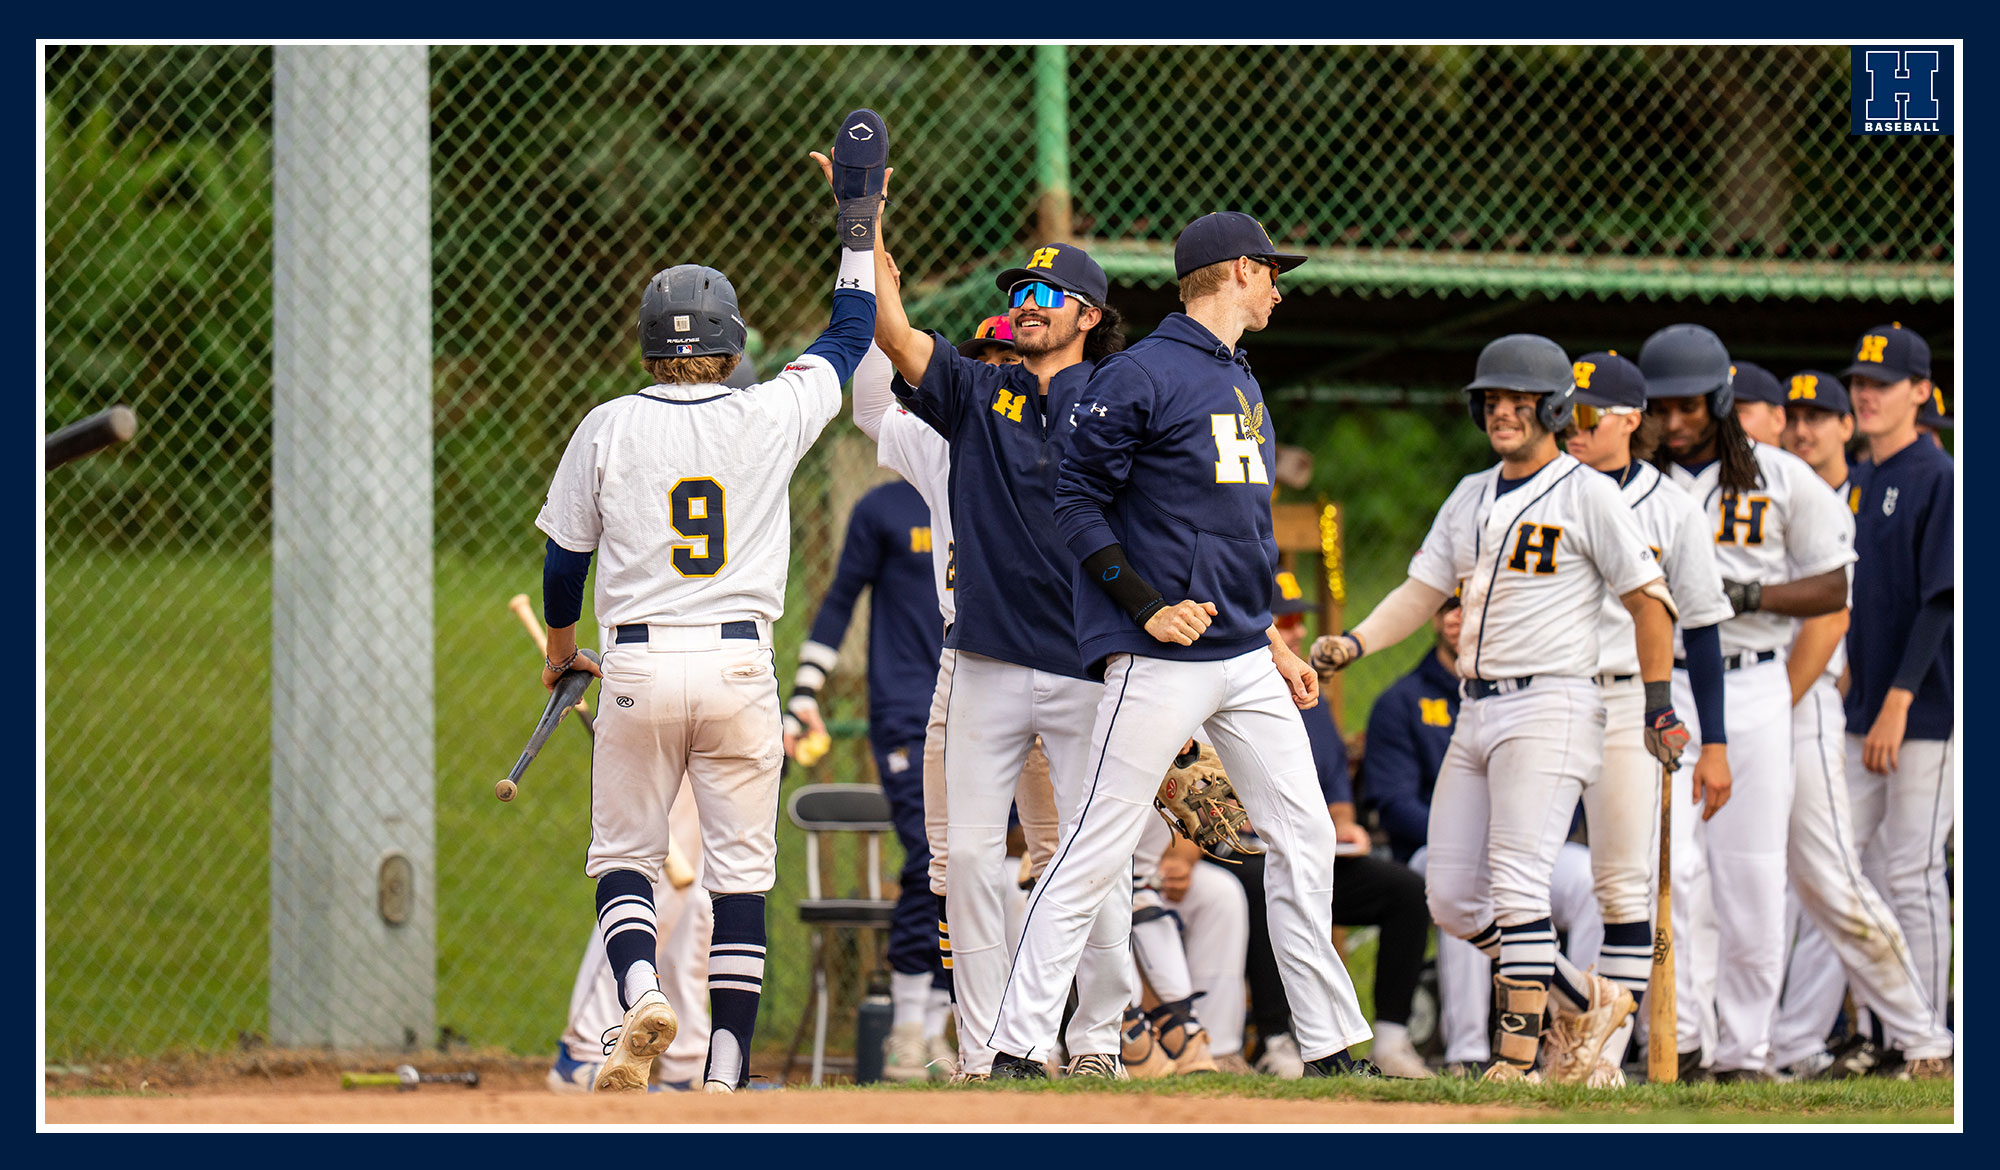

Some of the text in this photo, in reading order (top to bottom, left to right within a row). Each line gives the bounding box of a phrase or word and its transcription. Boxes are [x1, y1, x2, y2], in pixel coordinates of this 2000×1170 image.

[1026, 247, 1060, 269] H
[1857, 335, 1889, 364] H
[992, 388, 1027, 423] H
[1788, 374, 1819, 400] H
[1210, 413, 1269, 486] H
[668, 476, 728, 578] 9
[1714, 493, 1771, 547] H
[1507, 521, 1564, 576] H
